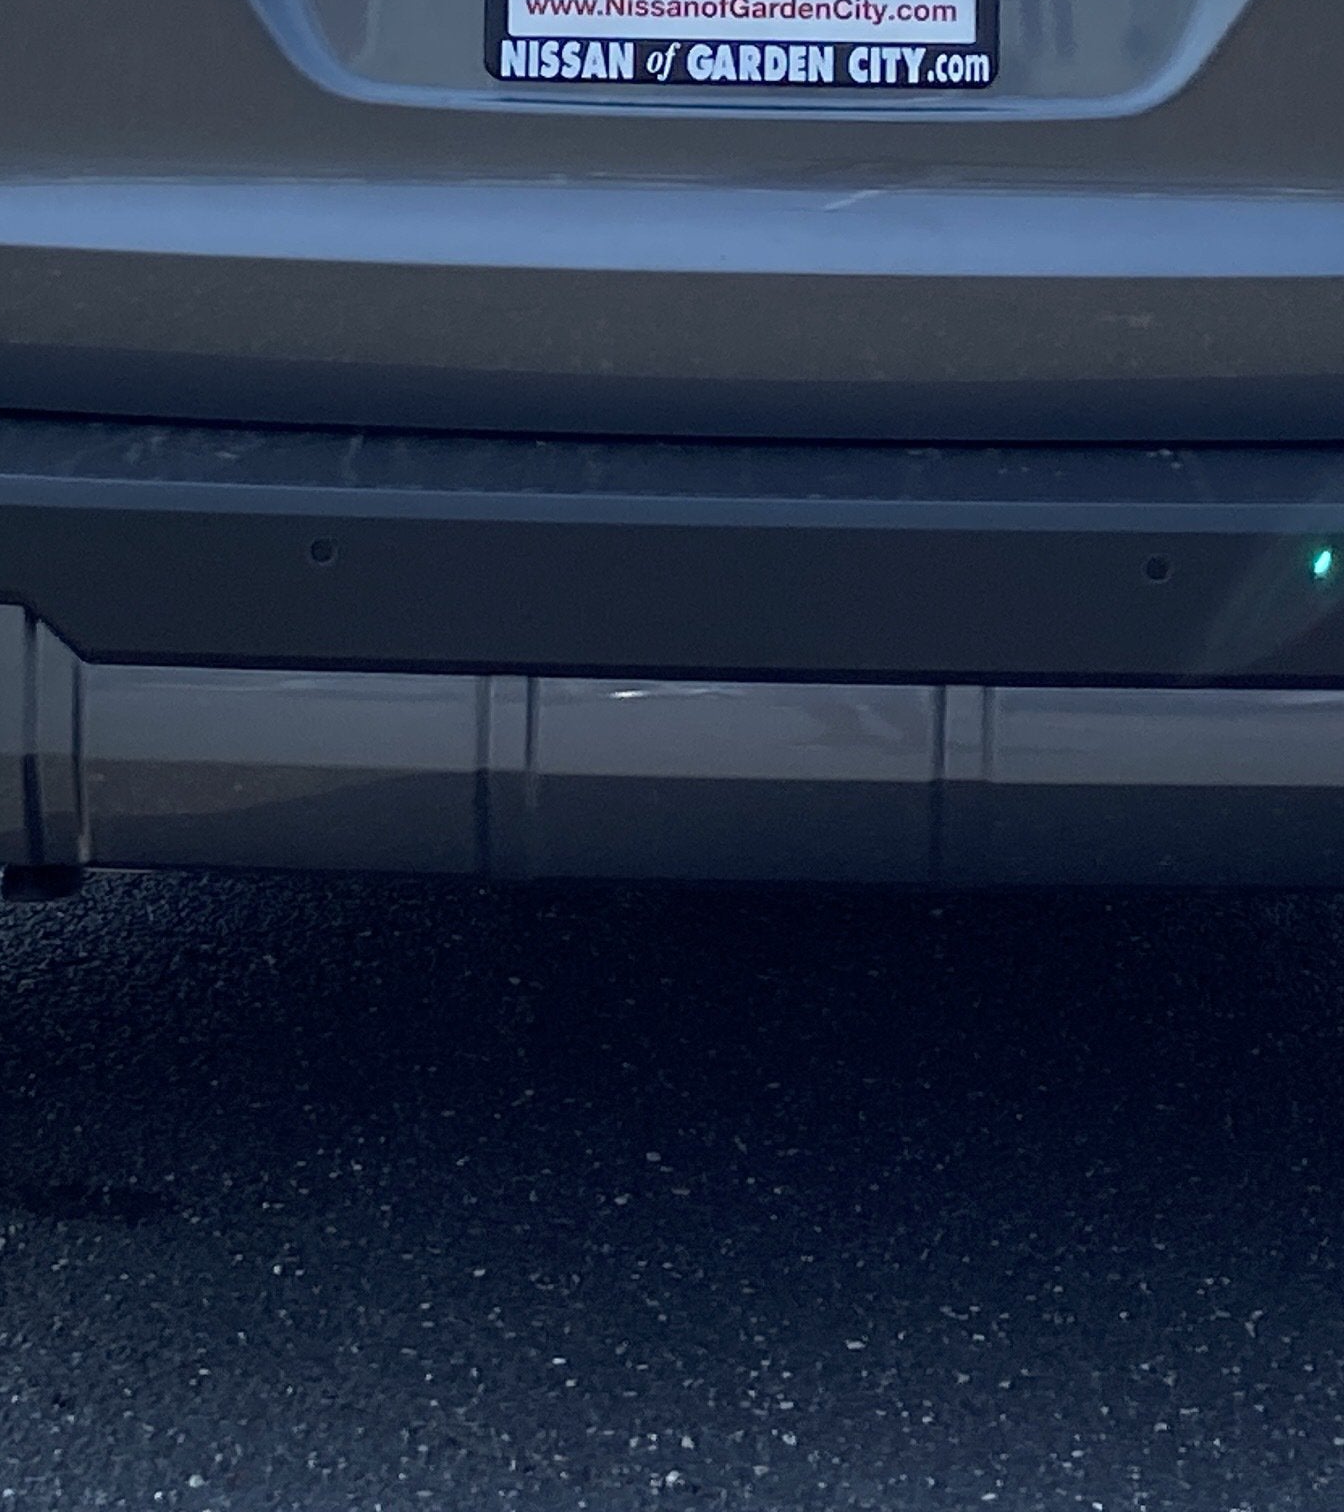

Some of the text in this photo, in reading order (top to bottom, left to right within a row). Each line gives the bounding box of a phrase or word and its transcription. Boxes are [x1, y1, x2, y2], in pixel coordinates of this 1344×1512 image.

[500, 39, 991, 84] NISSAN of GARDEN CITY.com
